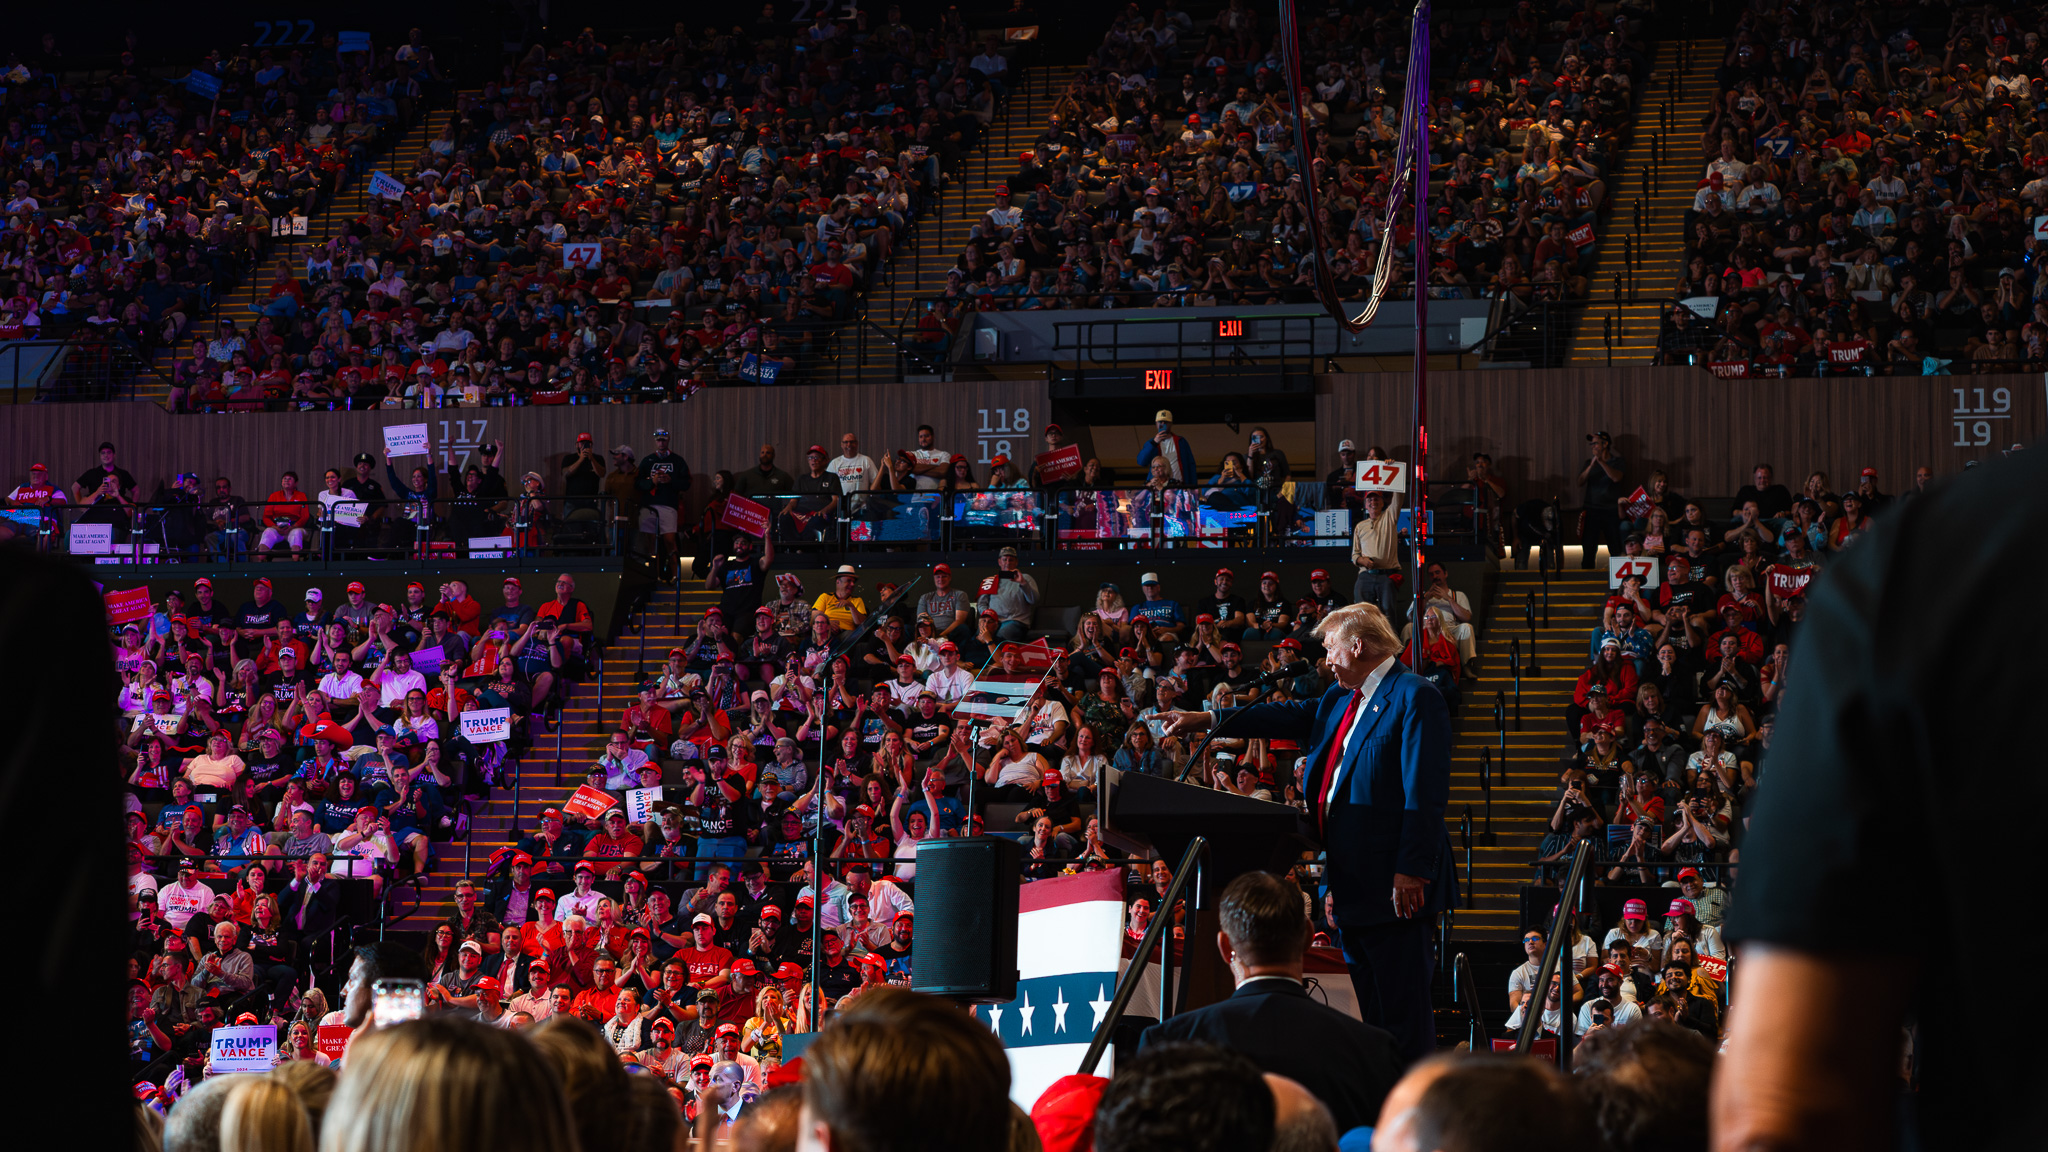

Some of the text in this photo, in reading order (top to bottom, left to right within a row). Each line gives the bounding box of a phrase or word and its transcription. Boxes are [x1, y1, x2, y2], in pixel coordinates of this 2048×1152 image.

[253, 19, 316, 47] 222
[1010, 28, 1035, 40] 47
[375, 177, 402, 194] TRUMP
[1229, 185, 1253, 201] 47
[568, 247, 597, 264] 47
[1710, 365, 1745, 378] TRUMP
[1145, 370, 1173, 390] EXIT
[1953, 387, 2011, 413] 119
[978, 408, 1030, 432] 118
[404, 434, 425, 442] AMERICA
[439, 420, 488, 443] 117
[1953, 421, 1991, 446] 19
[978, 440, 1012, 464] 18
[439, 451, 471, 473] 17
[1055, 455, 1078, 465] AMERICA
[1060, 461, 1077, 470] AGAIN
[1361, 465, 1400, 485] 47
[18, 489, 48, 501] TRUMP
[729, 510, 746, 520] GREAT
[745, 507, 766, 521] AMERICA
[1615, 562, 1652, 581] 47
[1773, 572, 1810, 588] TRUMP
[125, 597, 148, 606] AMERICA
[929, 600, 953, 613] USA
[111, 603, 147, 614] GREAT AGAIN
[138, 719, 178, 728] TUMP
[464, 716, 507, 727] TRUMP
[470, 724, 503, 734] VANCE
[325, 803, 358, 813] TRUMP
[573, 798, 601, 811] GREAT AGAIN
[588, 797, 607, 809] AMERICA
[644, 791, 653, 821] VANCE
[702, 819, 733, 831] VANCE
[600, 844, 623, 857] USA
[215, 1037, 273, 1049] TRUMP
[220, 1048, 266, 1058] VANCE
